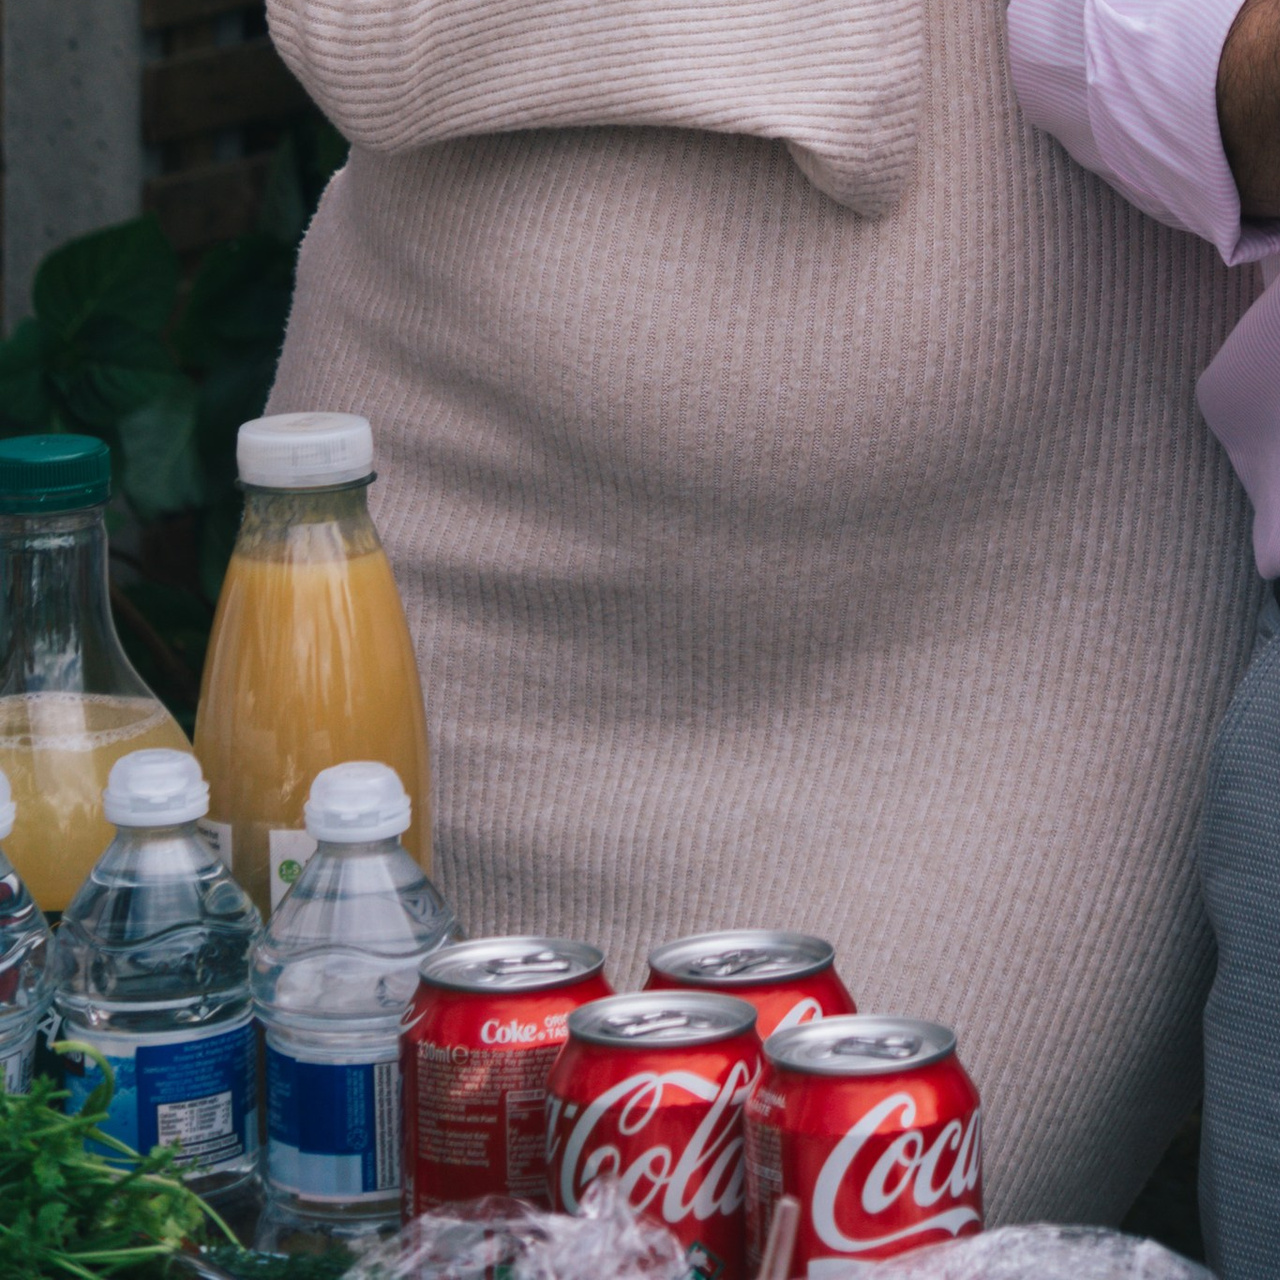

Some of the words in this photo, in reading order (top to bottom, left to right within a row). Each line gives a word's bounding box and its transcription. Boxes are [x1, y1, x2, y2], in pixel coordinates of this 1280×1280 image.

[417, 1039, 450, 1064] 330ml
[481, 1018, 537, 1045] Coke
[561, 1054, 762, 1223] Cola
[812, 1091, 981, 1252] Coca
